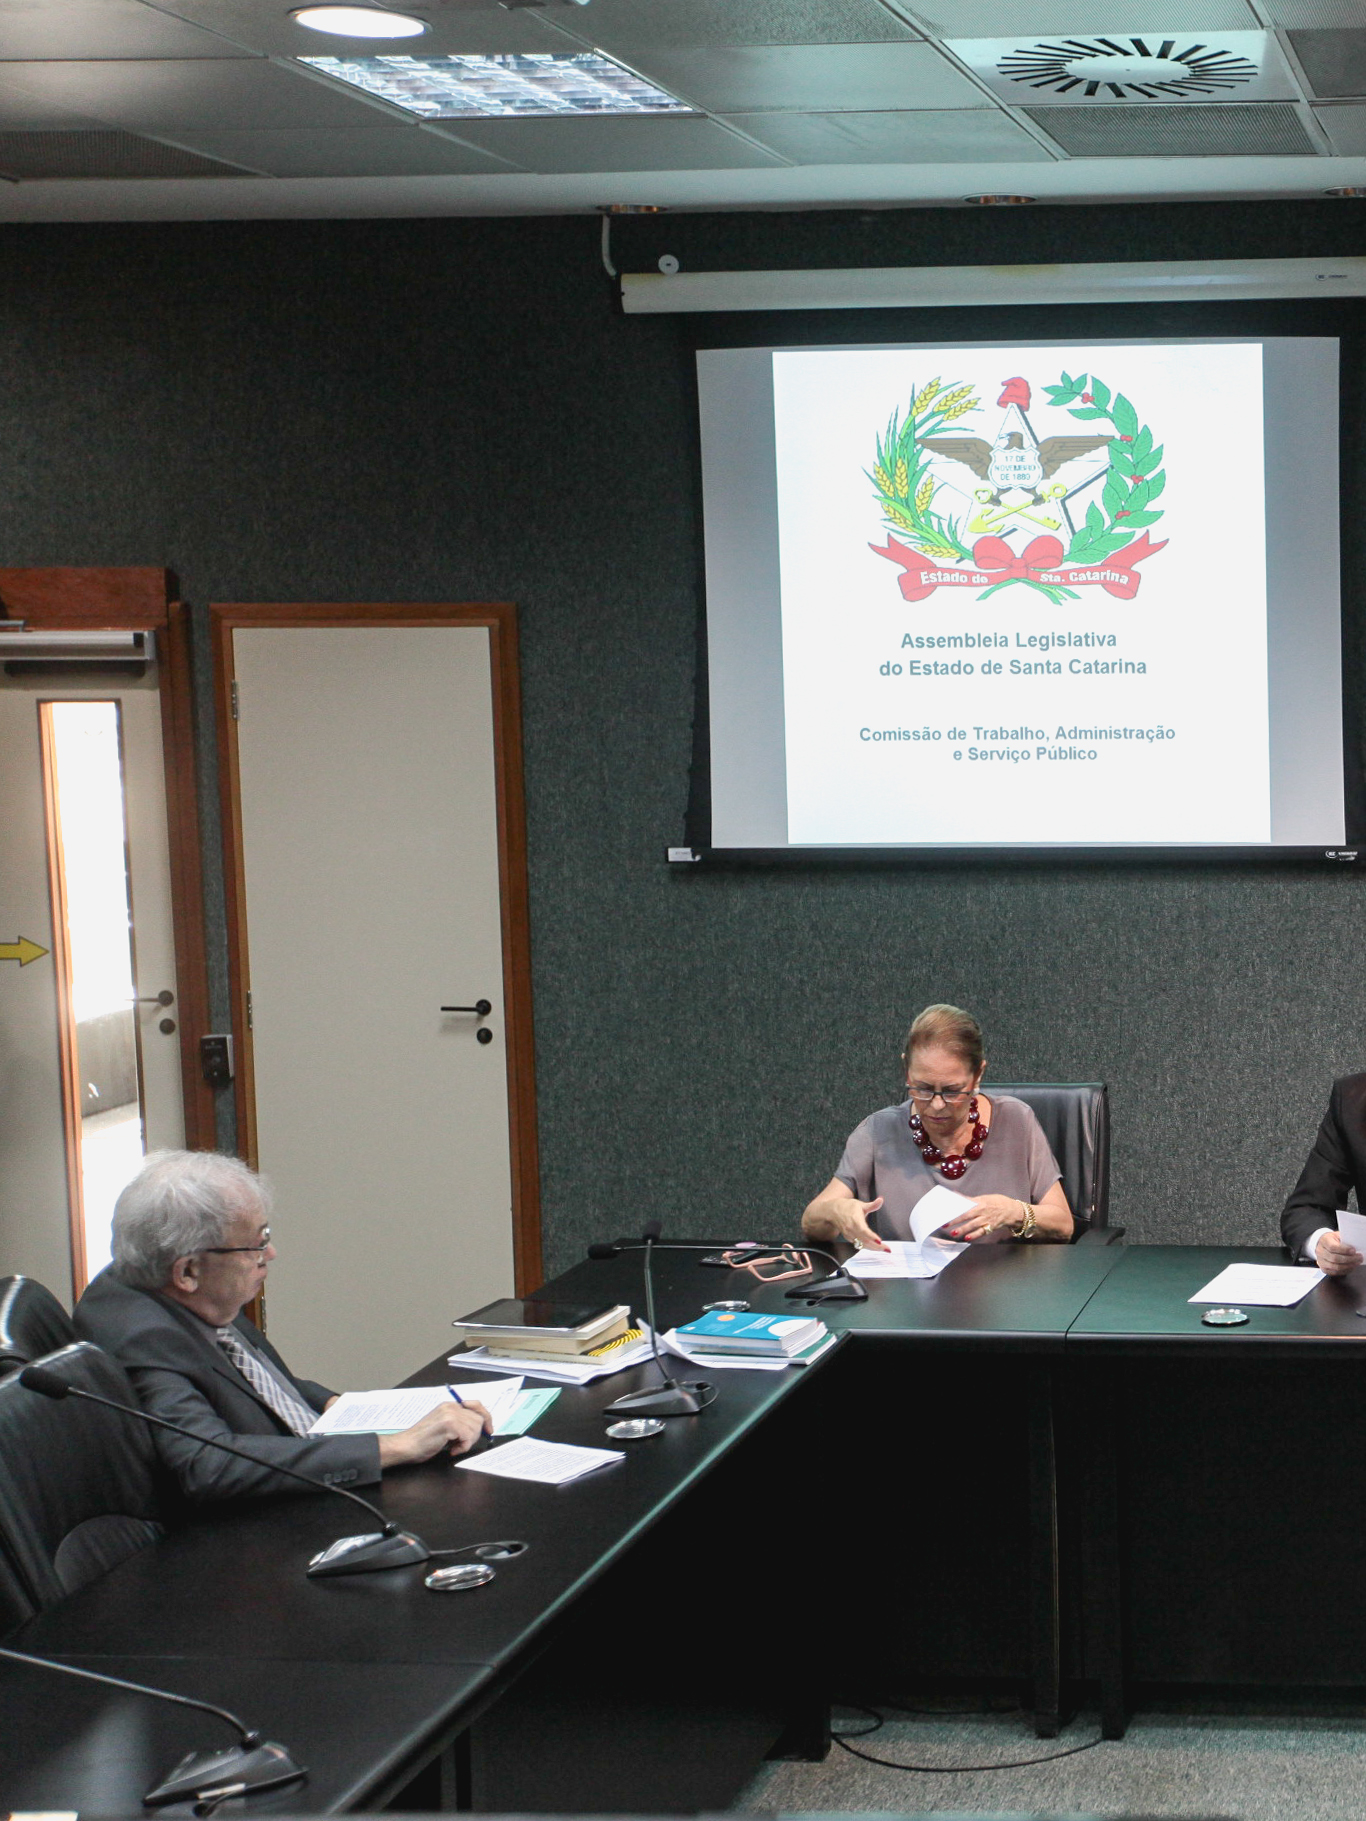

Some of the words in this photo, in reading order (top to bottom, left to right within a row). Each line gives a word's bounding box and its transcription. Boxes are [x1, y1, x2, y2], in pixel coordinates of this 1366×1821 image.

[1000, 473, 1010, 481] DE
[920, 571, 968, 585] Estado
[1040, 573, 1066, 583] Sta.
[1068, 569, 1129, 585] Catarina
[901, 632, 1009, 648] Assembleia
[1016, 631, 1117, 651] Legislativa
[879, 660, 903, 676] do
[909, 660, 974, 675] Estado
[981, 659, 1003, 675] de
[1009, 659, 1062, 675] Santa
[1068, 658, 1147, 675] Catarina
[859, 726, 942, 741] Comissão
[947, 727, 967, 741] de
[973, 726, 1050, 742] Trabalho,
[1055, 725, 1176, 743] Administração
[953, 750, 962, 761] e
[967, 746, 1031, 763] Serviço
[1036, 745, 1098, 761] Público
